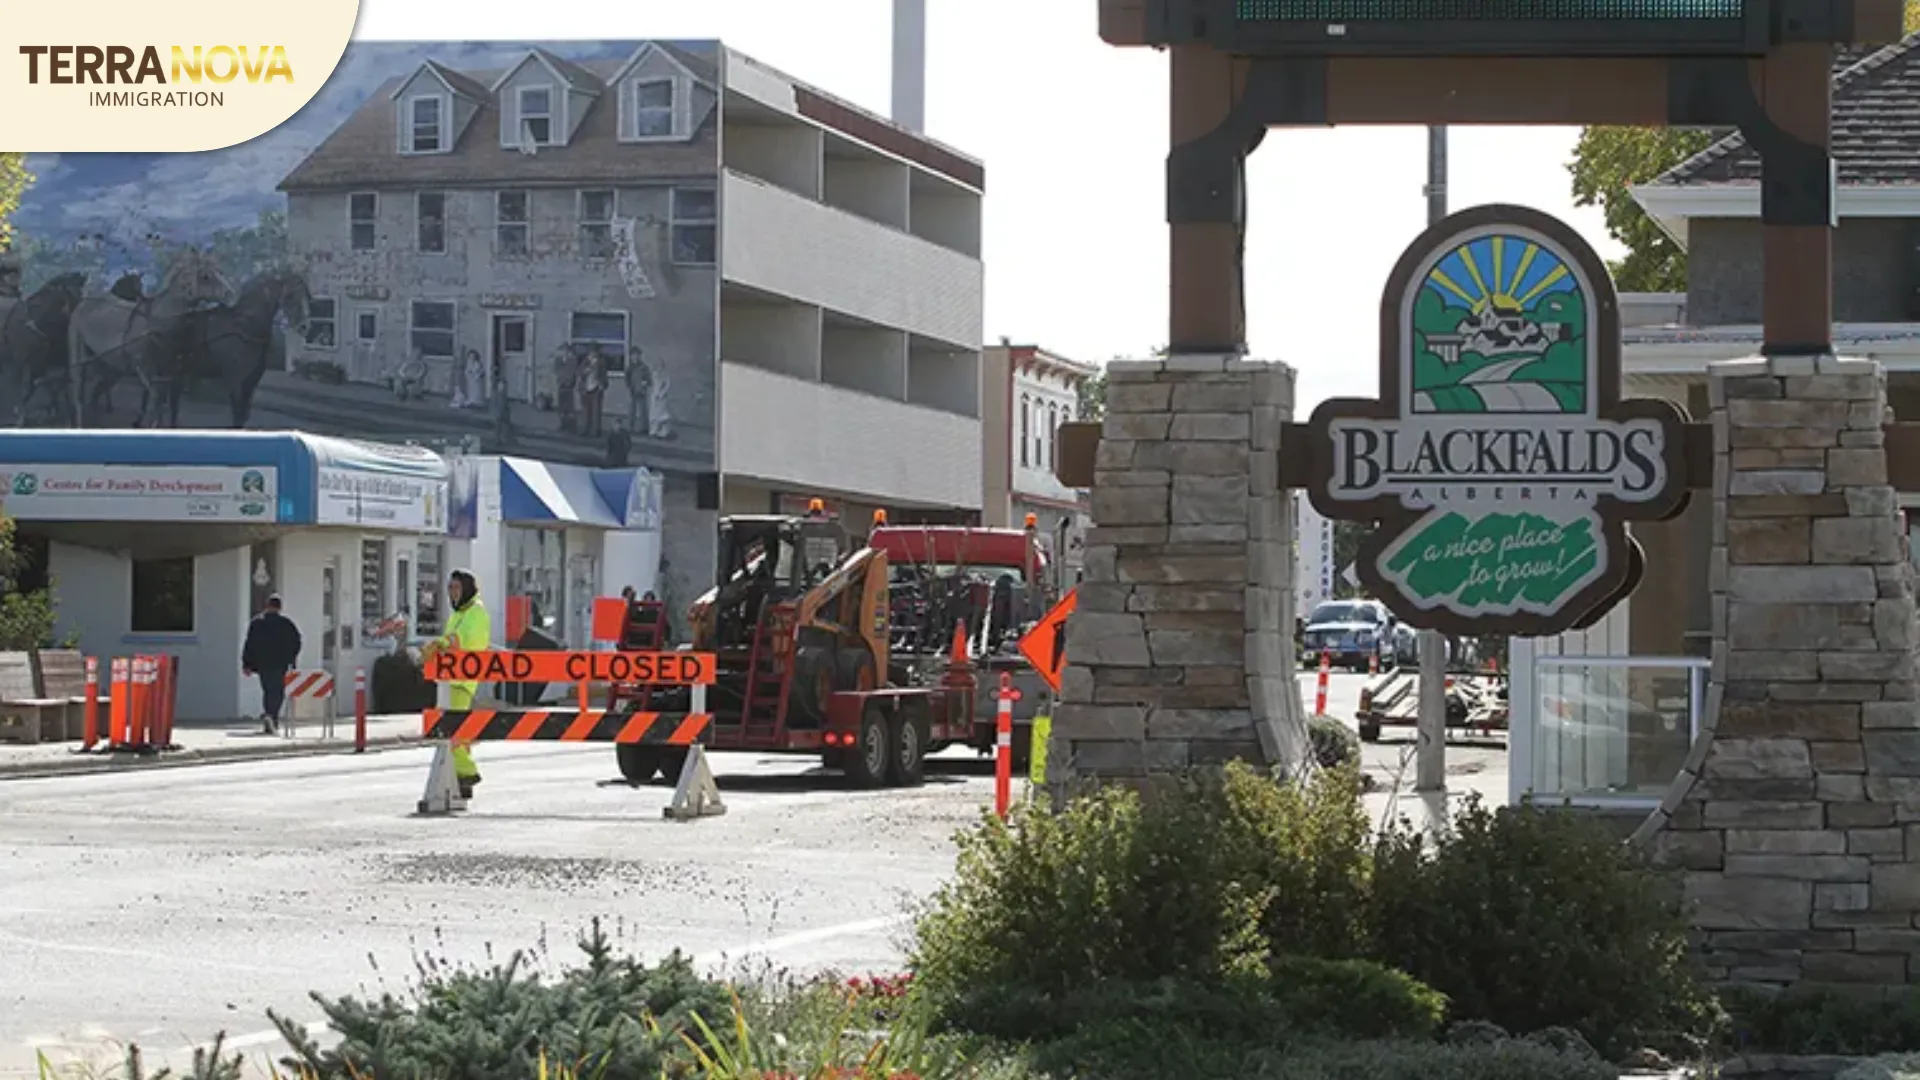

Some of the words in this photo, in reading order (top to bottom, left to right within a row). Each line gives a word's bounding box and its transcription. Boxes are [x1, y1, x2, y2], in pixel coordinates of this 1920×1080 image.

[1338, 427, 1657, 492] BLACKFALDS
[86, 477, 104, 491] for
[107, 478, 146, 495] Family
[149, 479, 223, 495] Development
[1411, 487, 1588, 500] ALBERTA
[1423, 543, 1441, 561] a
[1444, 533, 1496, 558] nice
[1498, 518, 1566, 563] place
[1467, 558, 1491, 586] to
[1494, 547, 1566, 593] grow!
[435, 652, 533, 680] ROAD
[565, 652, 703, 681] CLOSED
